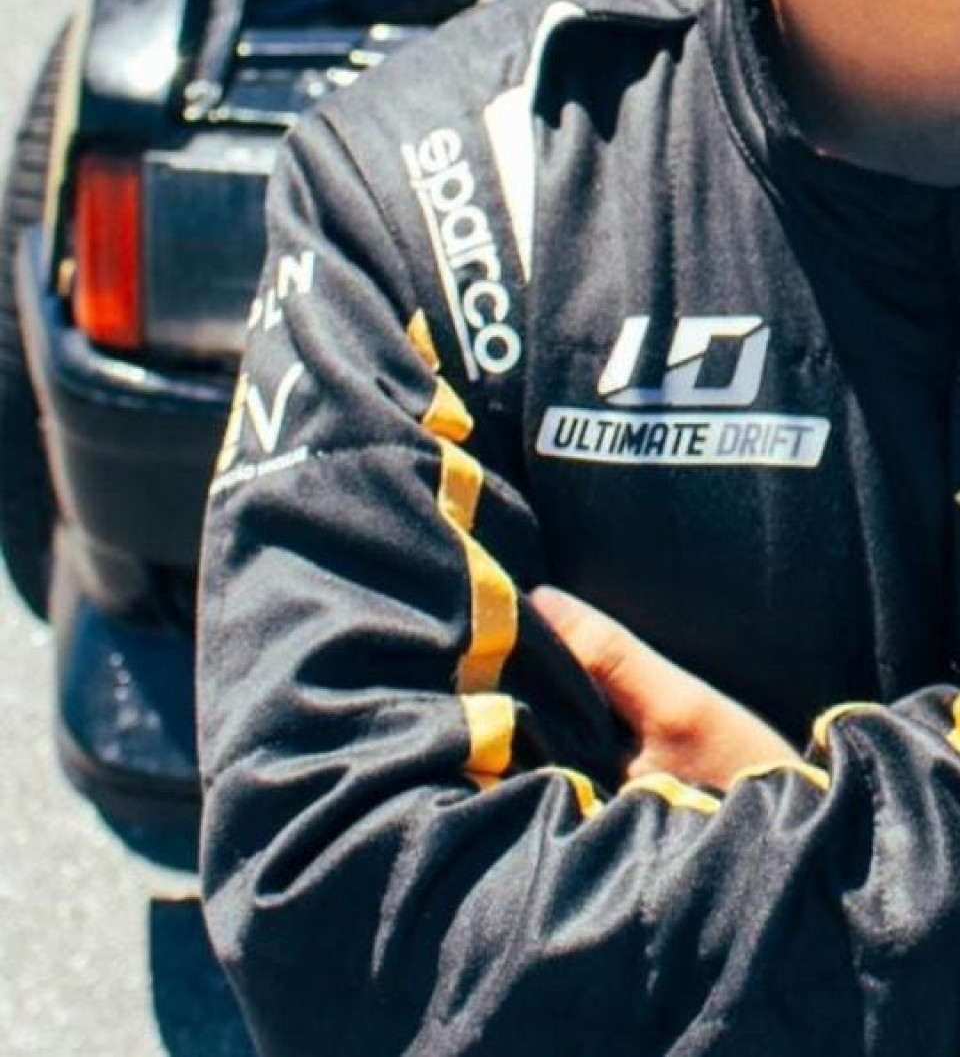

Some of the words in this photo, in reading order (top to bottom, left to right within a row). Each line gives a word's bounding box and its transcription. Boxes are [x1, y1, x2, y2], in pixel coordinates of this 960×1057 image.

[410, 129, 521, 375] sparco
[553, 415, 710, 456] ULTIMATE
[715, 423, 815, 460] DRIFT
